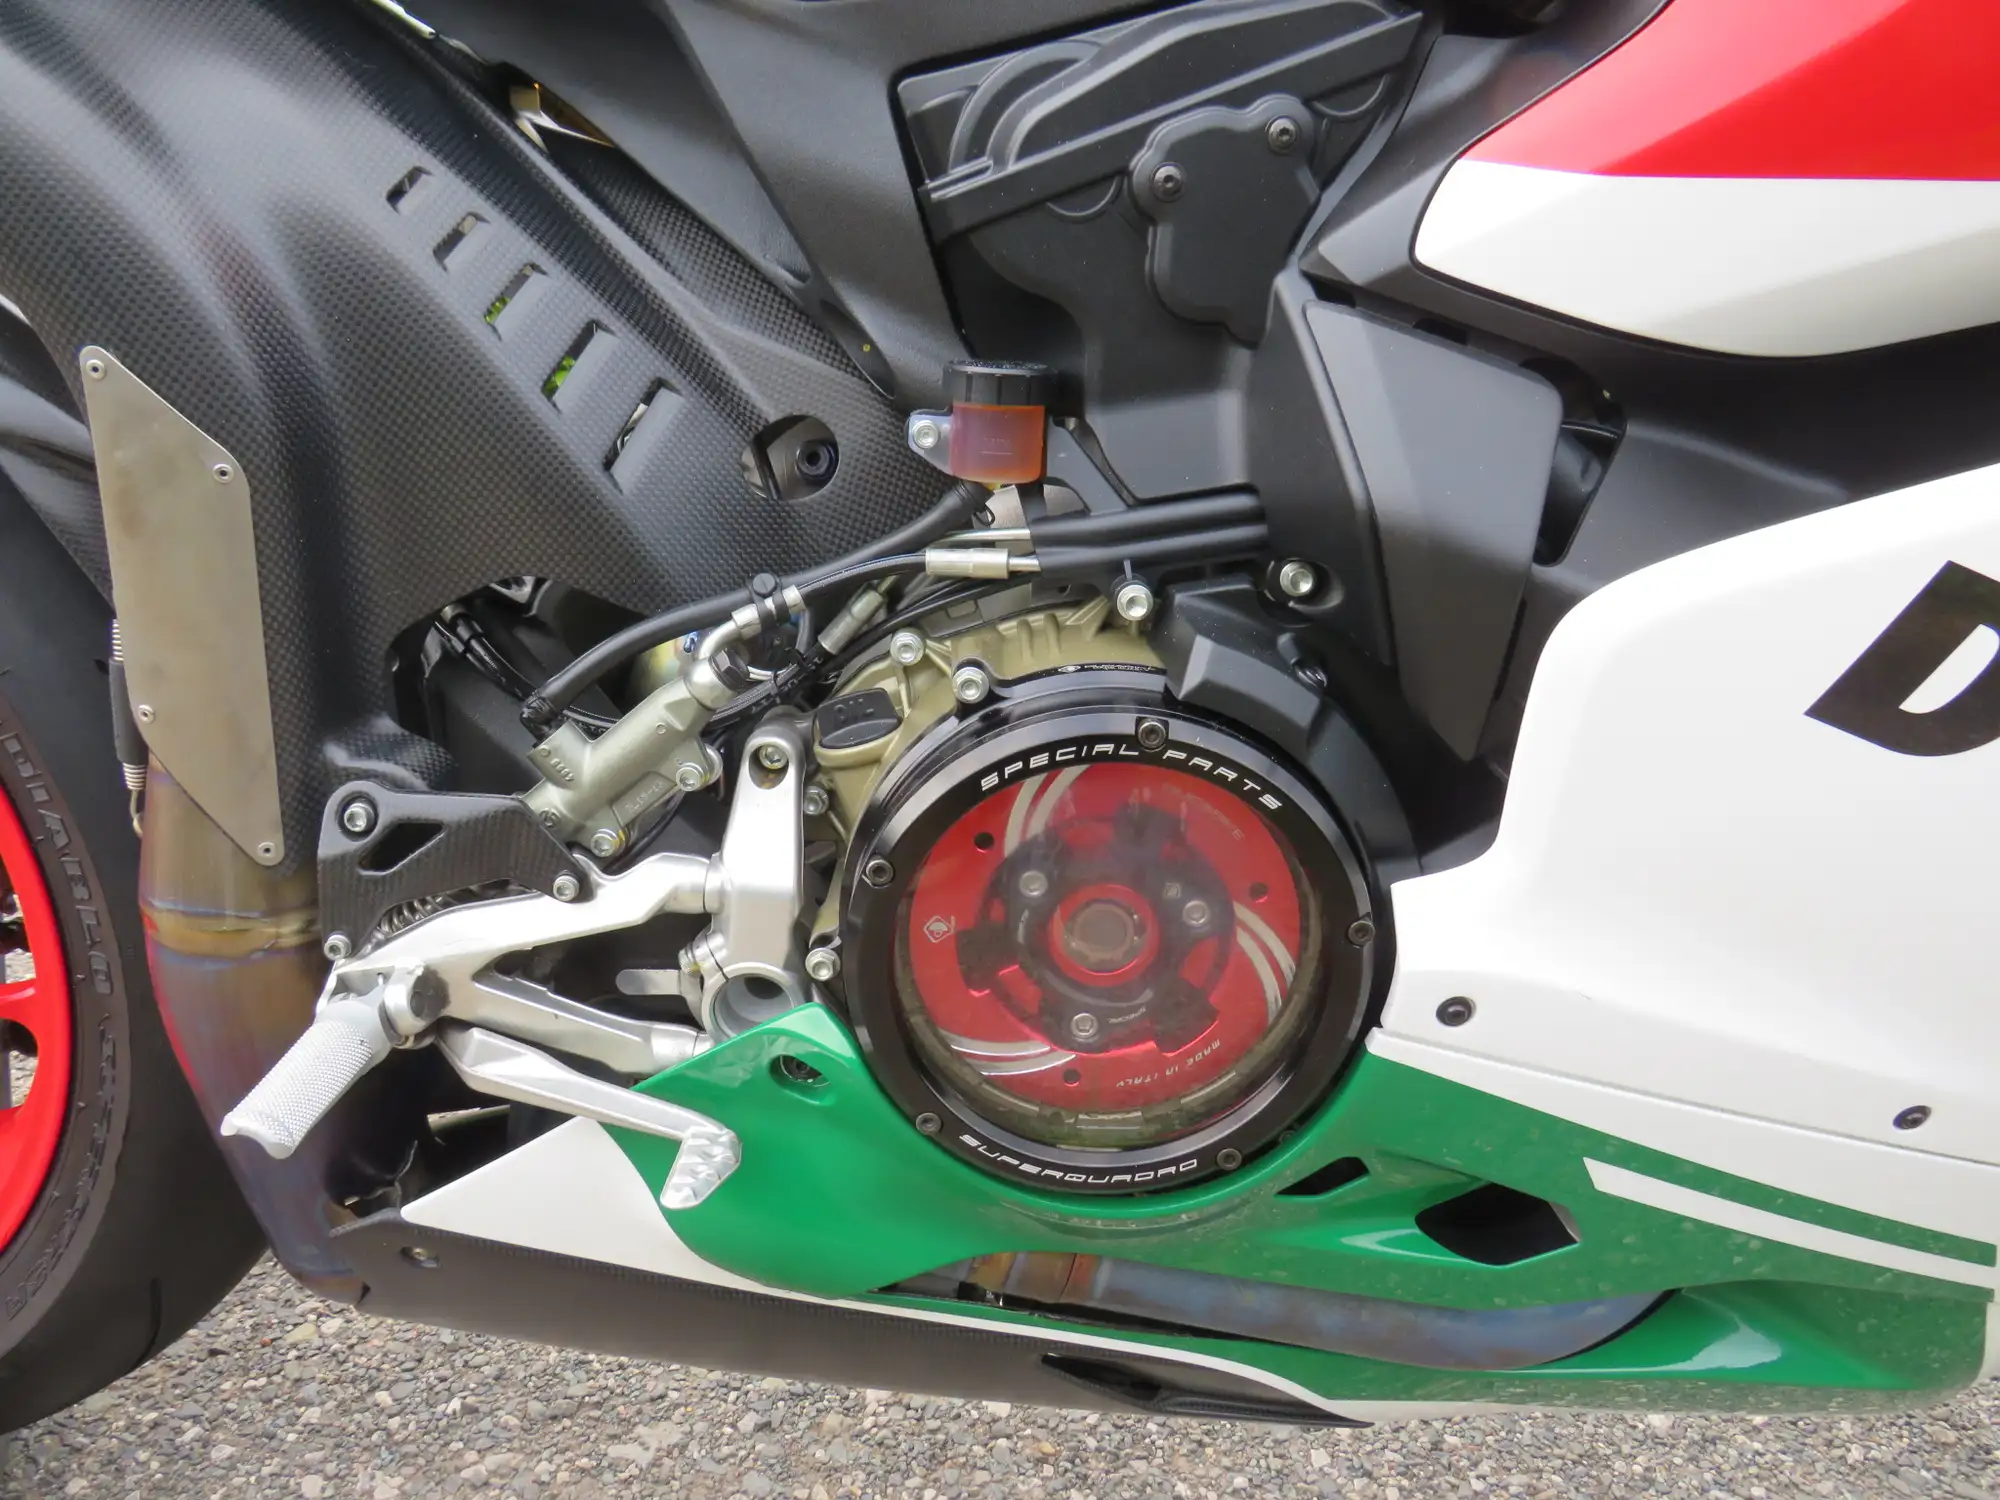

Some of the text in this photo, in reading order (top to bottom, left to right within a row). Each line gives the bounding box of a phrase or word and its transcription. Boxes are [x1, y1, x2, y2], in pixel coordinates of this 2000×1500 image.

[1803, 559, 2000, 757] D
[980, 743, 1284, 810] SPECIAL PARTS
[0, 732, 113, 995] DIABLO
[1116, 1072, 1158, 1088] ITALY
[1186, 1038, 1221, 1067] MADE
[958, 1133, 1198, 1184] SUPERQUADRO
